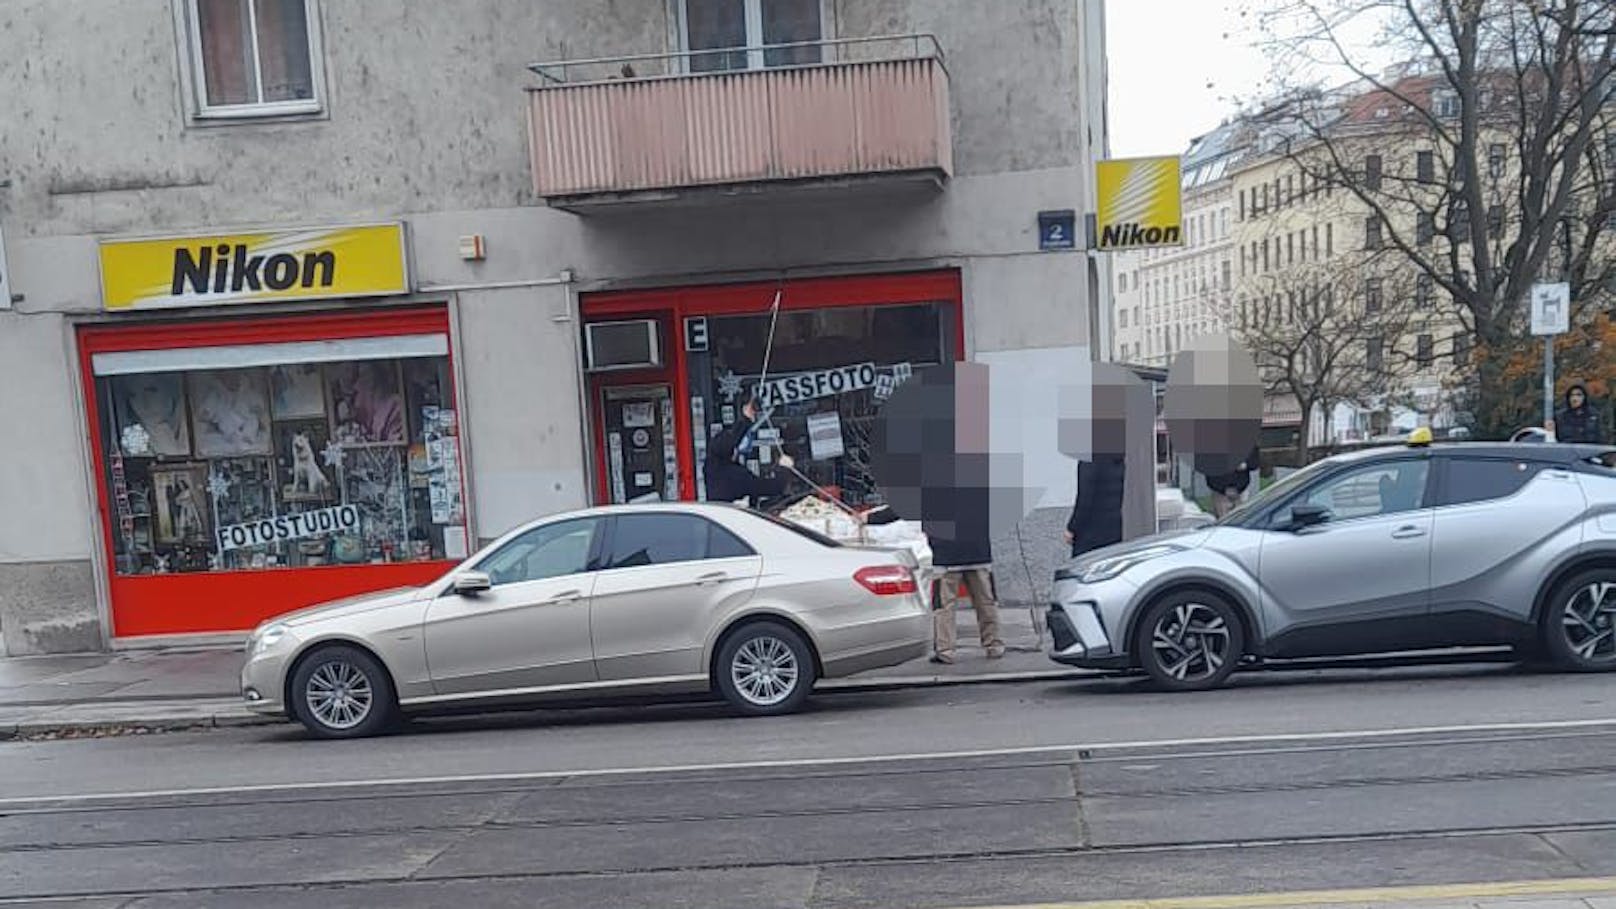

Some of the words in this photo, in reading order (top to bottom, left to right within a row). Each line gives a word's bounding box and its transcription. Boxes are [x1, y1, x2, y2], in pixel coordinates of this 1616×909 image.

[1049, 223, 1063, 239] 2
[1101, 223, 1180, 246] Nikon
[171, 243, 335, 296] Nikon
[218, 506, 357, 549] FOTOSTUDIO
